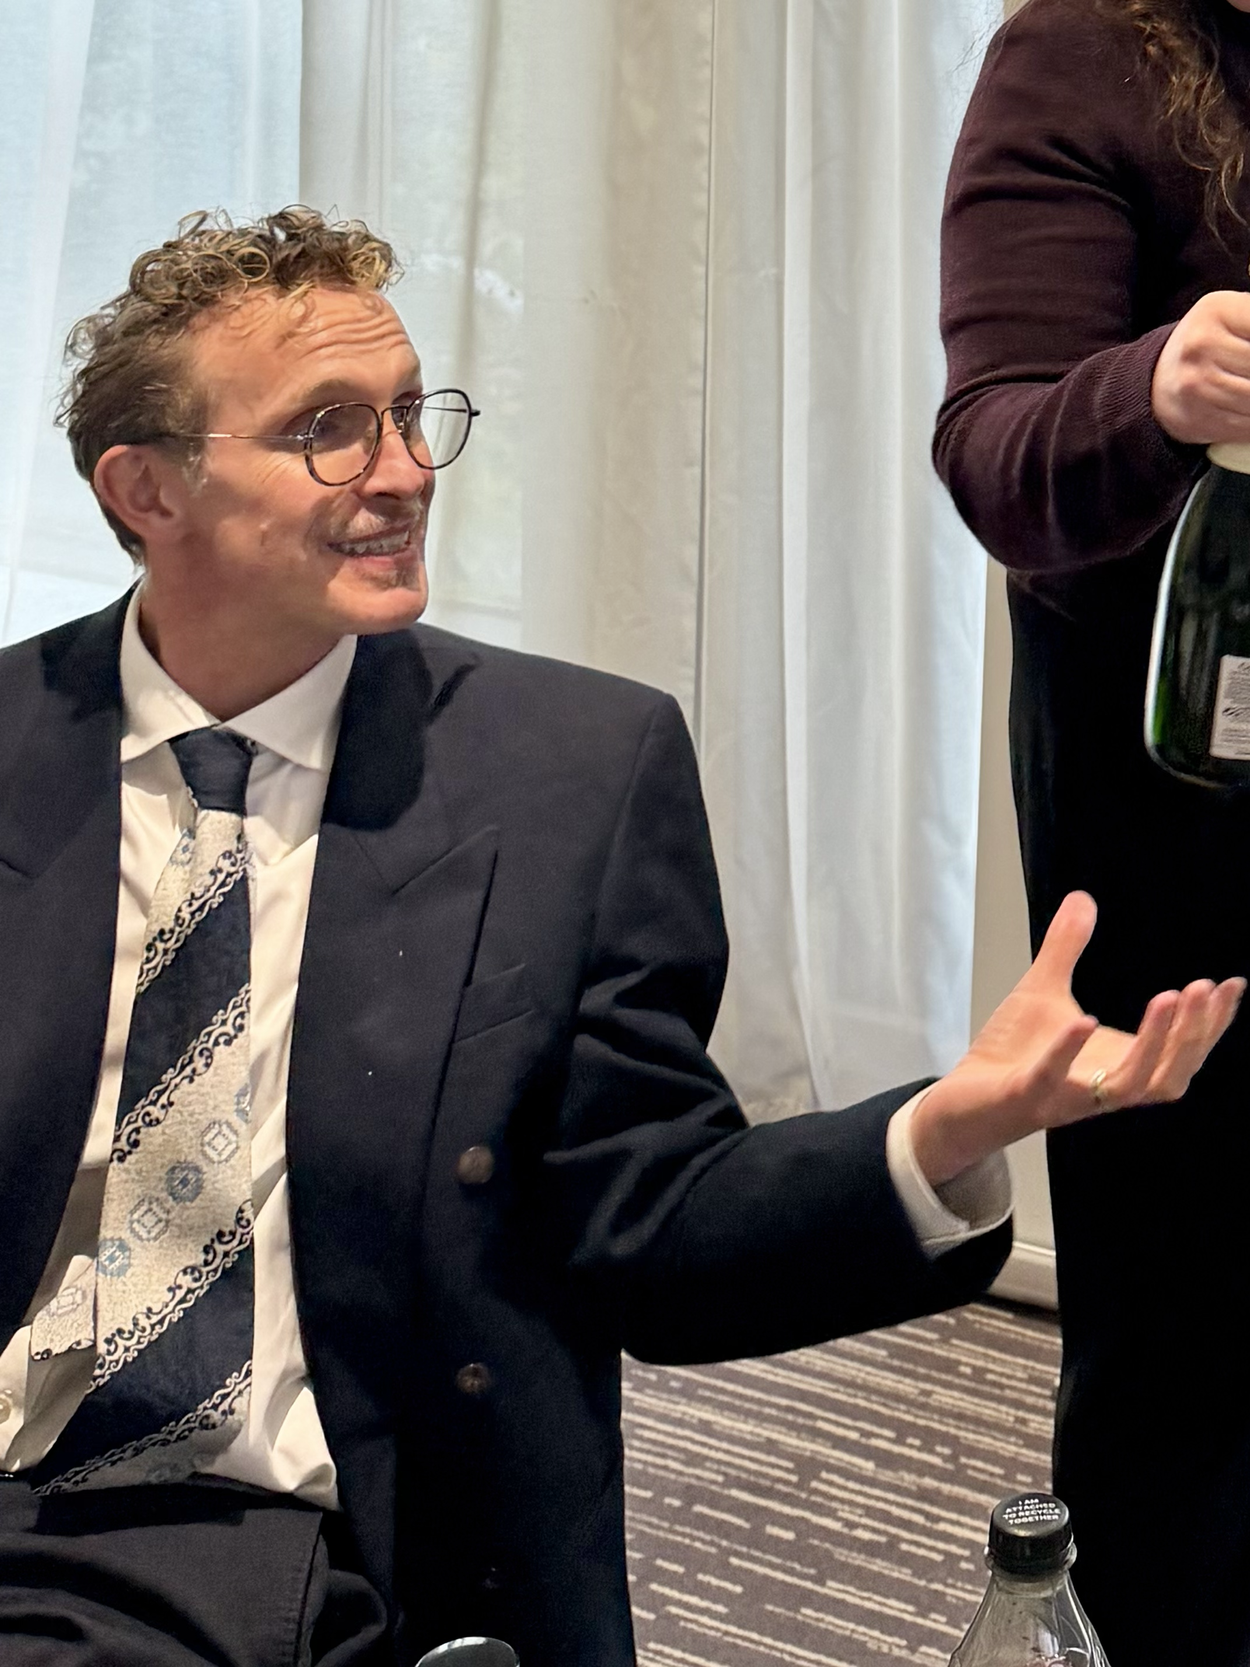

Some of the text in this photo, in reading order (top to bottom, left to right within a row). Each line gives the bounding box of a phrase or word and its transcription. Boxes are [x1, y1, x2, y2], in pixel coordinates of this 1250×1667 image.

[1005, 1502, 1056, 1514] ATTACHED
[1018, 1508, 1061, 1517] RECYCLE
[1008, 1514, 1059, 1525] TOGETHER
